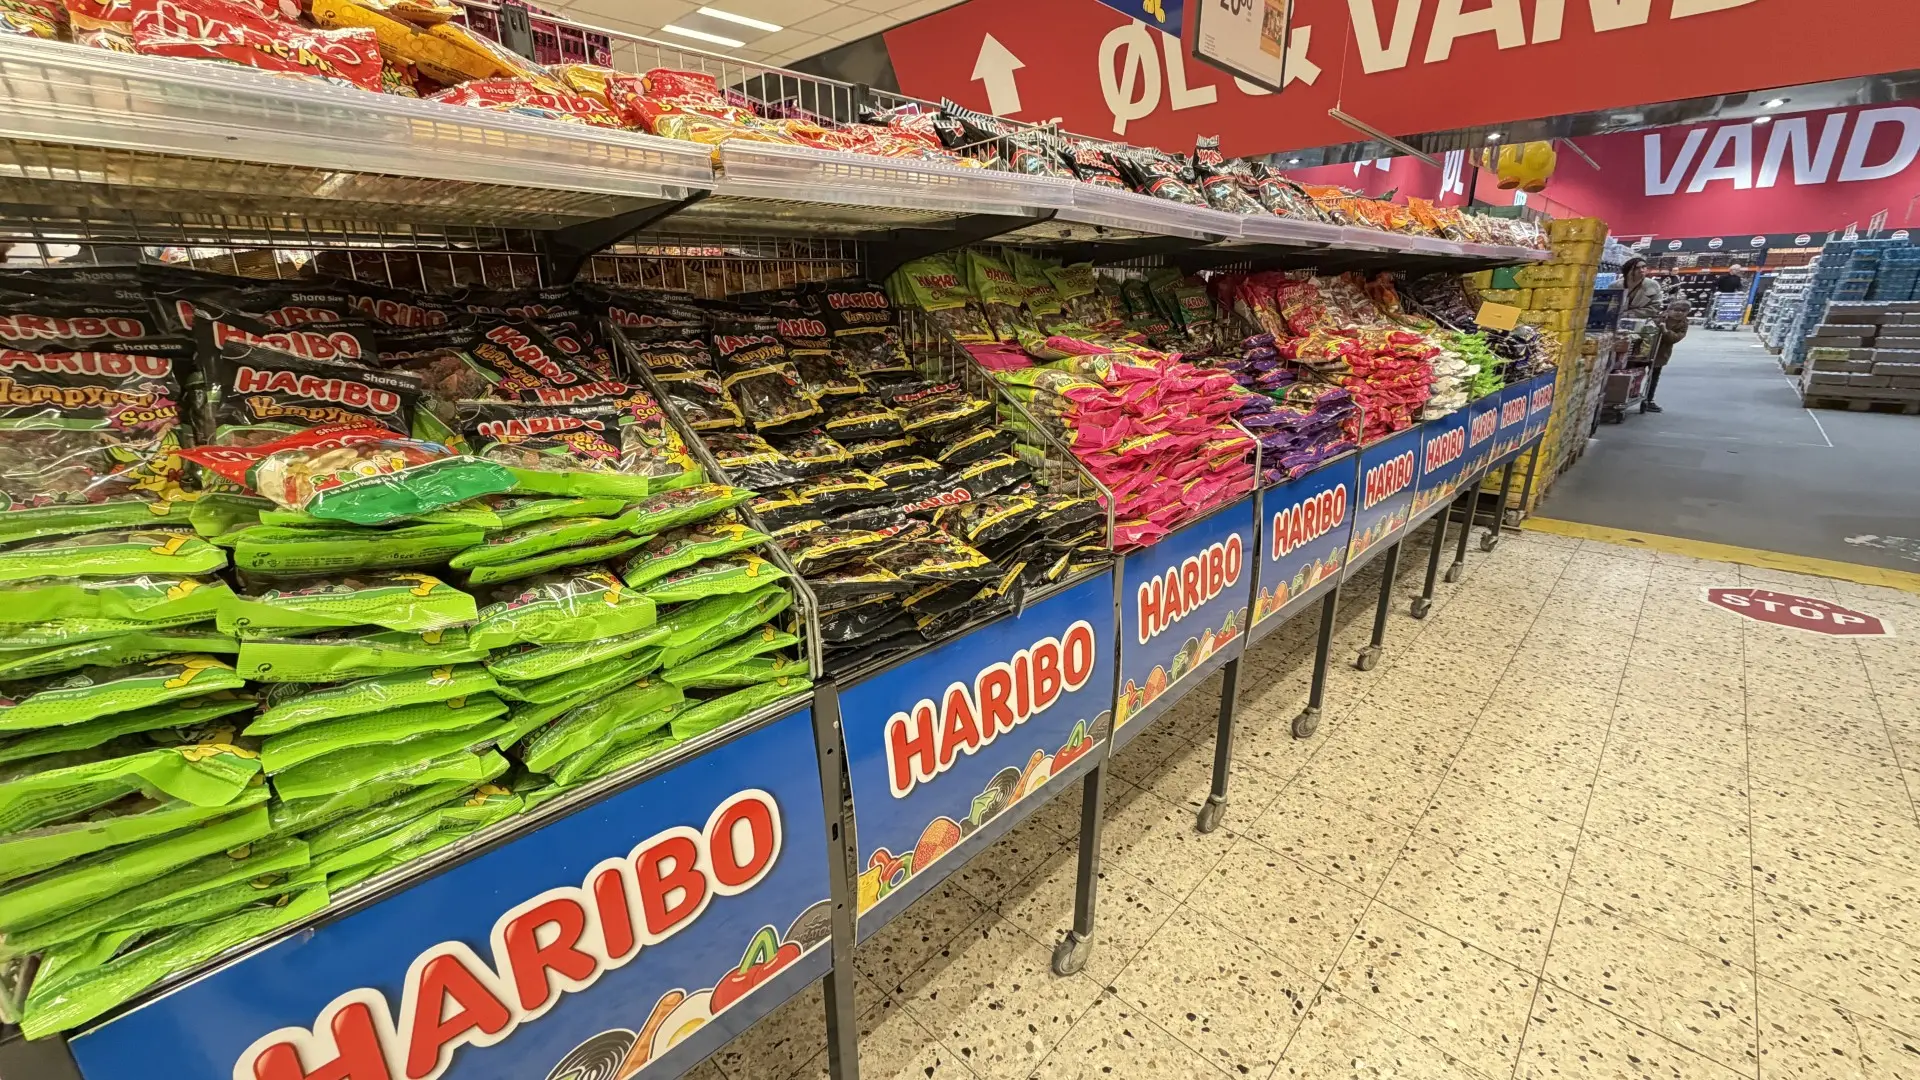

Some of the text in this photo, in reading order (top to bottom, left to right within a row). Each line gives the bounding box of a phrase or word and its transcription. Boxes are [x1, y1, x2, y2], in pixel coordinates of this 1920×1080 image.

[1098, 19, 1217, 135] ØL
[1644, 106, 1920, 196] VAND
[292, 293, 326, 302] Share
[827, 292, 888, 309] HARIBO
[113, 343, 158, 352] Share
[234, 365, 400, 414] HARIBO
[363, 373, 397, 386] Share
[1531, 383, 1553, 414] HARIBO
[1471, 407, 1498, 448] HARIBO
[1500, 395, 1527, 430] HARIBO
[1424, 426, 1465, 475] HARIBO
[1364, 450, 1414, 509] HARIBO
[1272, 484, 1346, 561] HARIBO
[1138, 533, 1243, 644] HARIBO
[1721, 593, 1866, 625] STOP
[885, 621, 1095, 797] HARIBO
